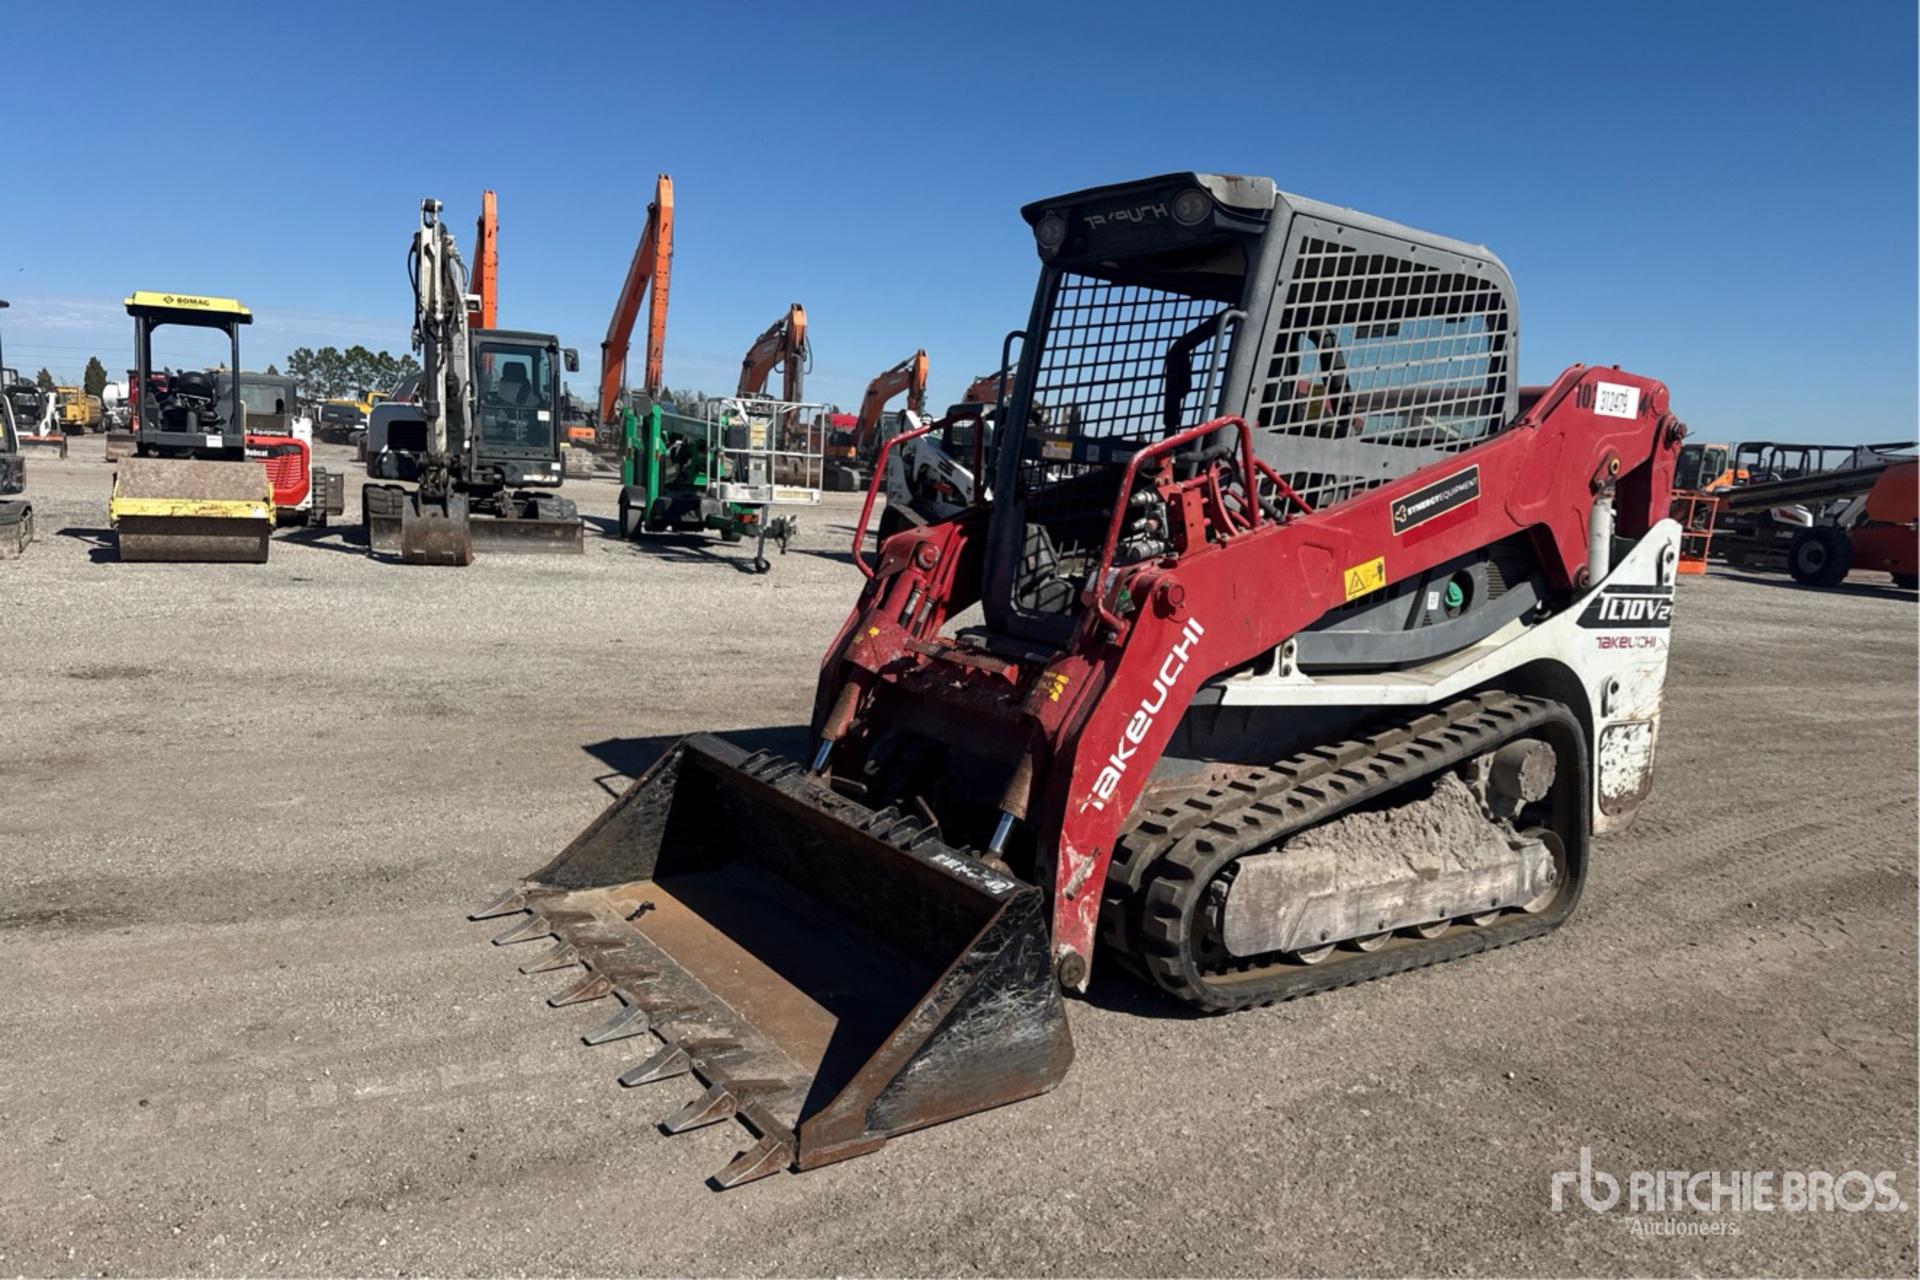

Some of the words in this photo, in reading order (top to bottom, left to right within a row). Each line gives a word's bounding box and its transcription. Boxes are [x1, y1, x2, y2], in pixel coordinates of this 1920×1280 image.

[177, 297, 210, 306] BOMAG
[1598, 594, 1672, 620] TL10V2
[1080, 617, 1205, 814] TAKEUCHI
